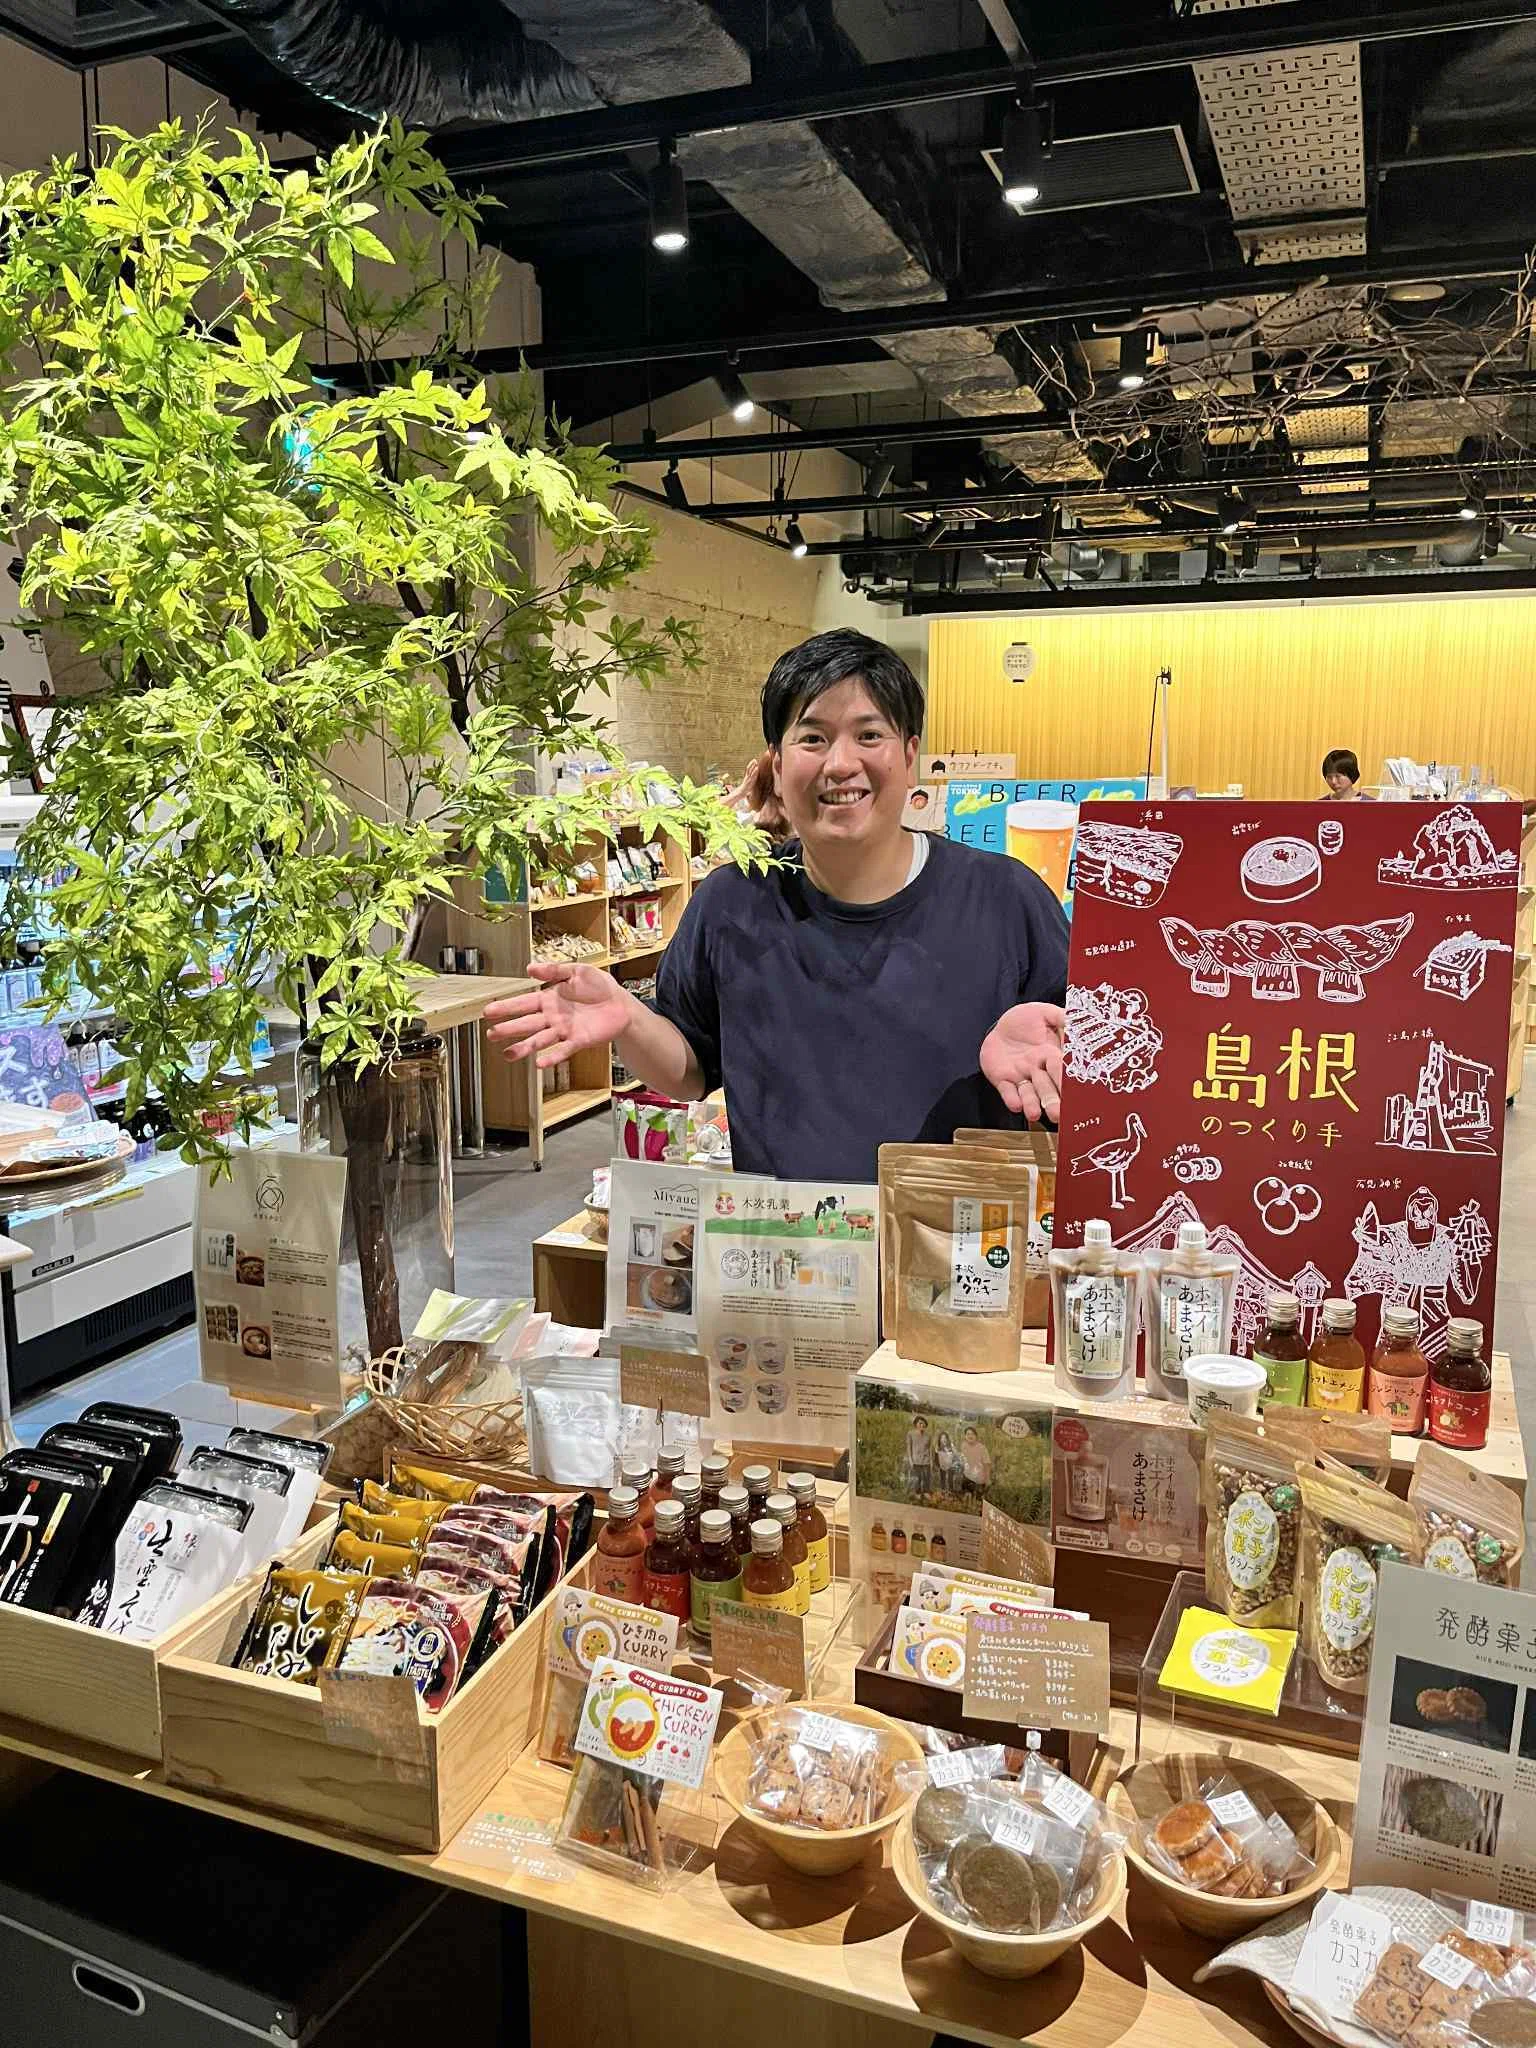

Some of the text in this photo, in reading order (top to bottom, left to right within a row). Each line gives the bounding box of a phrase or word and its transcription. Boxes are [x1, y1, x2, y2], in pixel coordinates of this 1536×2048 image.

[990, 783, 1077, 803] BEER
[1192, 1022, 1359, 1112] 島根
[1201, 1116, 1343, 1148] のつくり手
[653, 1189, 697, 1205] Miyauc
[1097, 1283, 1115, 1333] ホエイ
[1195, 1285, 1212, 1334] ホエイ
[1081, 1284, 1100, 1362] あまさけ
[1131, 1451, 1149, 1521] あまさけ
[594, 1599, 616, 1614] SPICE
[616, 1606, 642, 1619] CURRY
[623, 1639, 669, 1663] CURRY
[634, 1673, 703, 1700] SPICE CURRY KIT
[653, 1698, 713, 1725] CHICKEN
[663, 1715, 708, 1740] CURRY
